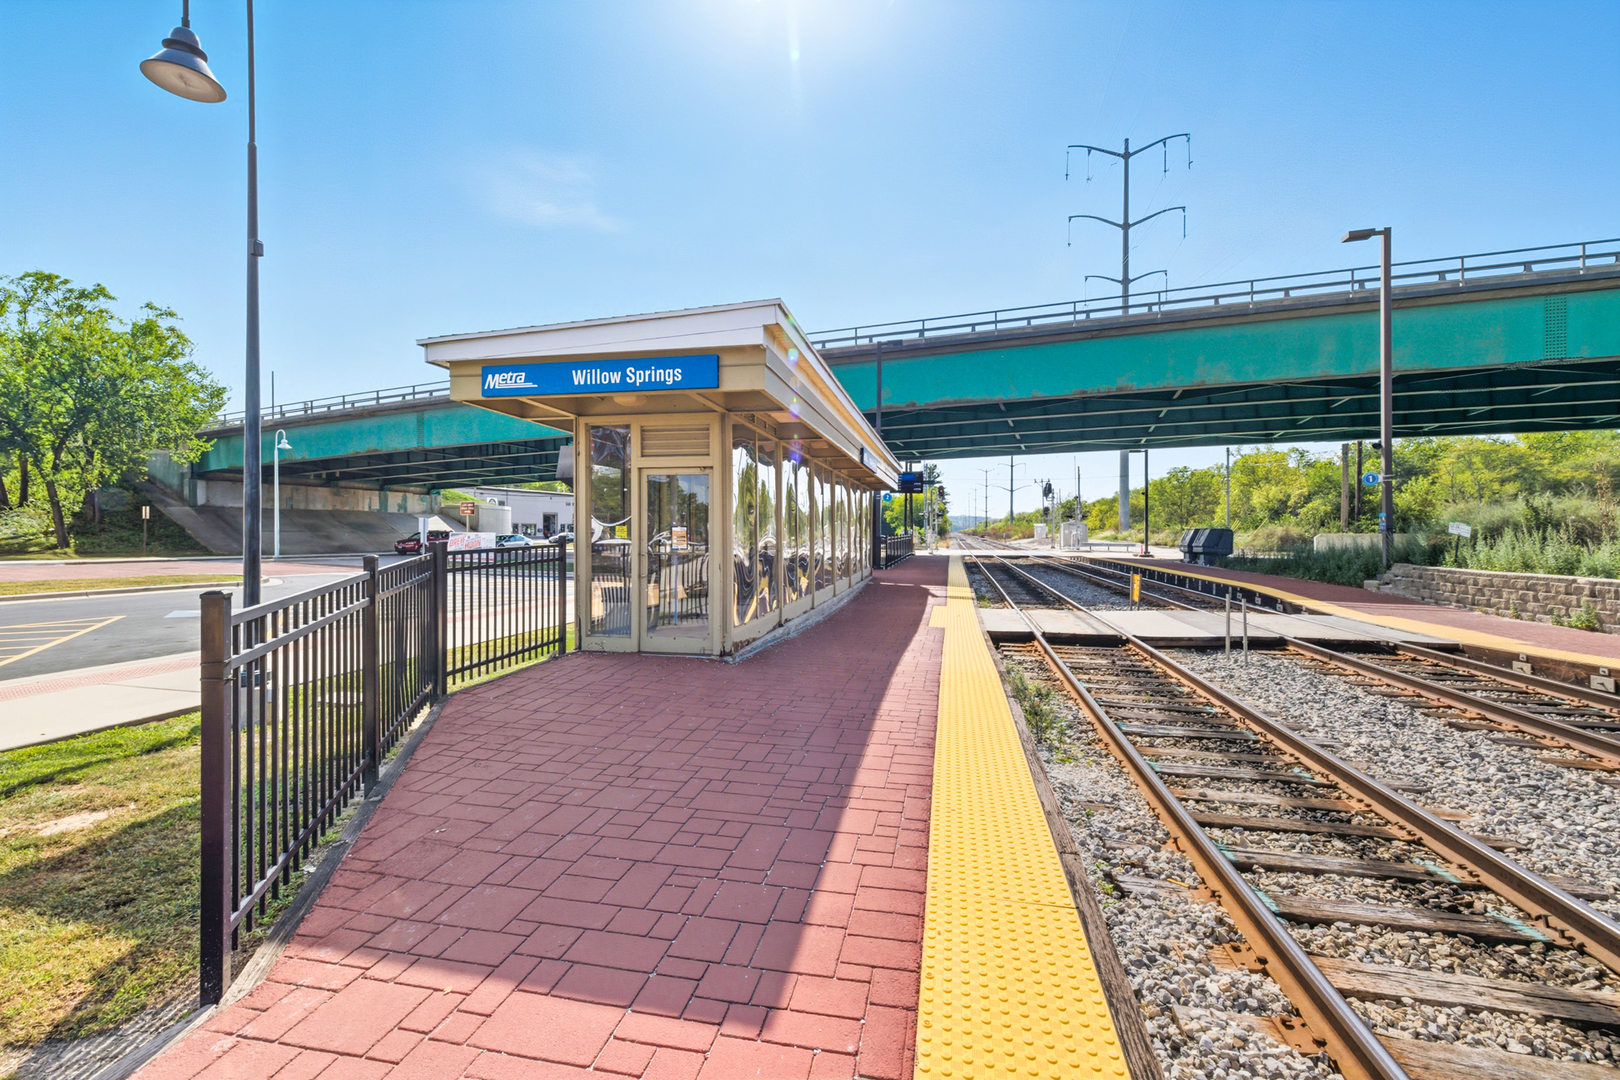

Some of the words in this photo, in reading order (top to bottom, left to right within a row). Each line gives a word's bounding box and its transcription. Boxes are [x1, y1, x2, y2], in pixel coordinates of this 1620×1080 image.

[484, 371, 526, 389] Metra
[572, 369, 621, 385] Willow
[626, 366, 682, 386] Springs
